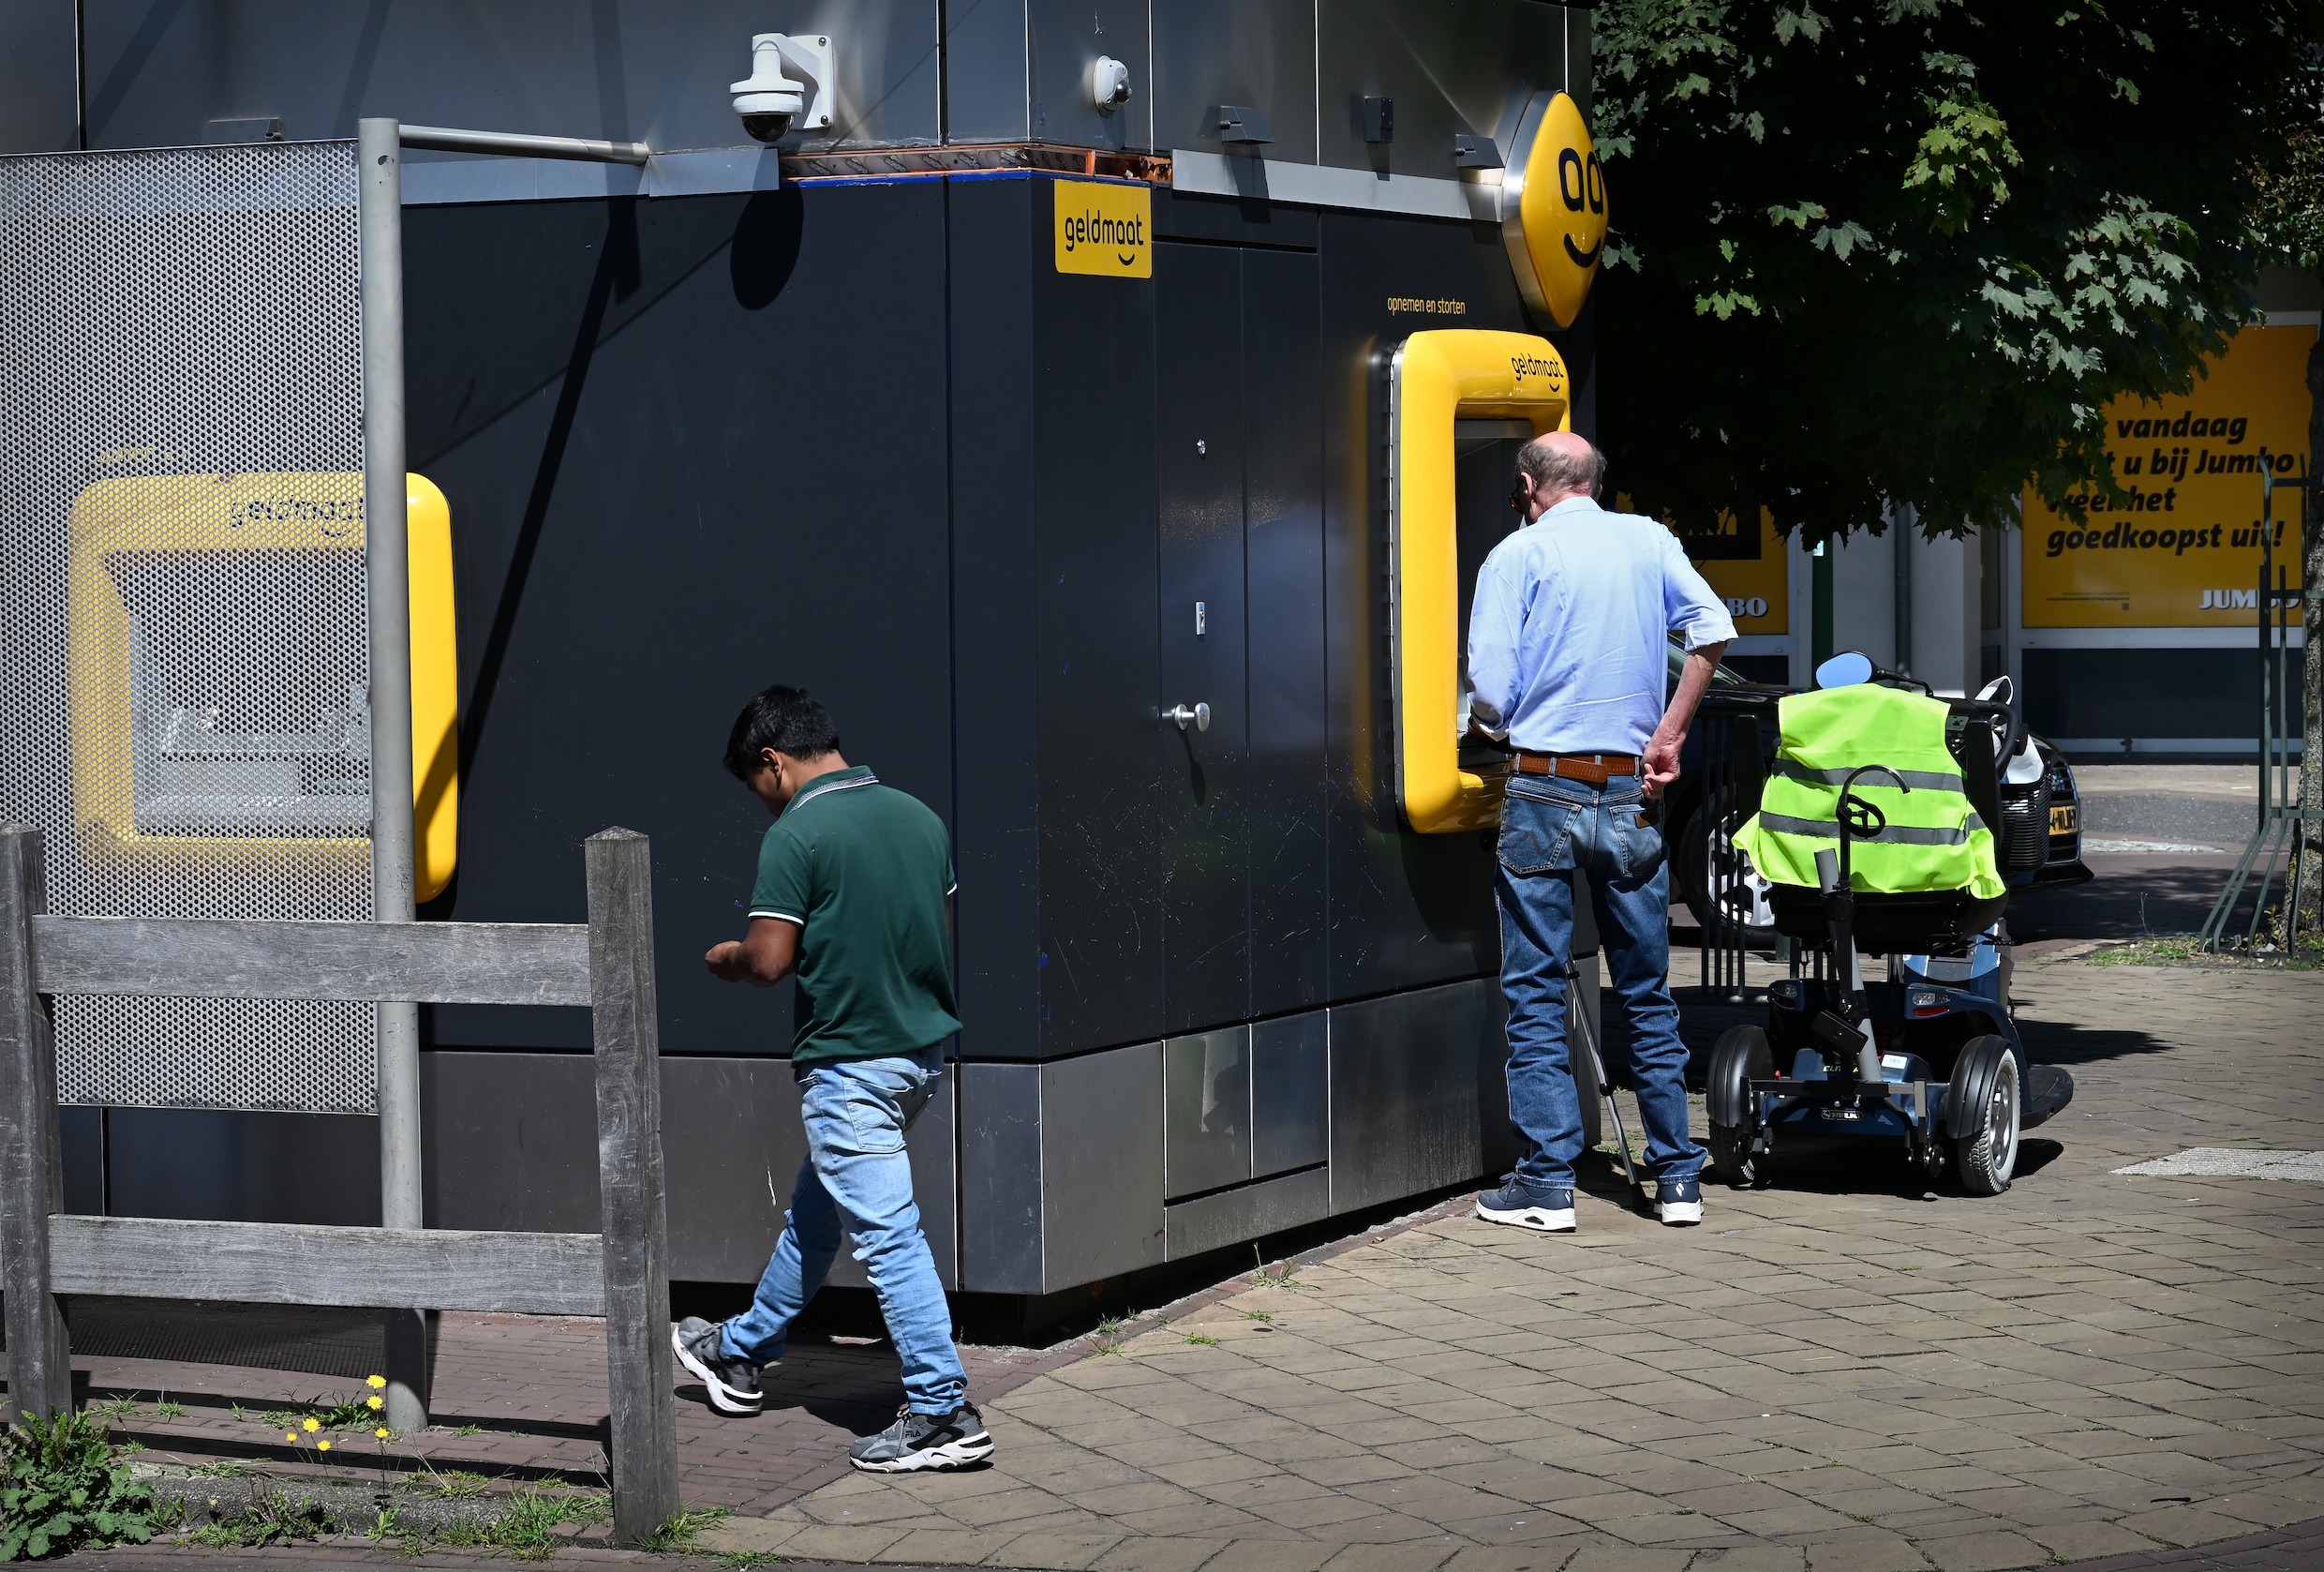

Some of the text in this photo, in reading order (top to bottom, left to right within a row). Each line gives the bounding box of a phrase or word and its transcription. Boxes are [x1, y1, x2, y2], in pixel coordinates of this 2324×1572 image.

[1065, 208, 1144, 252] geldmaat
[1387, 296, 1467, 317] opnemen en storten
[1511, 352, 1564, 382] geldmaat
[2117, 411, 2248, 445] vandaag
[2123, 456, 2142, 475] u
[2150, 447, 2190, 483] bij
[2194, 446, 2294, 475] Jumbo
[2126, 485, 2177, 512] het
[2047, 522, 2222, 557] goedkoopst
[2199, 589, 2301, 610] JUM
[905, 1430, 921, 1438] FILA
